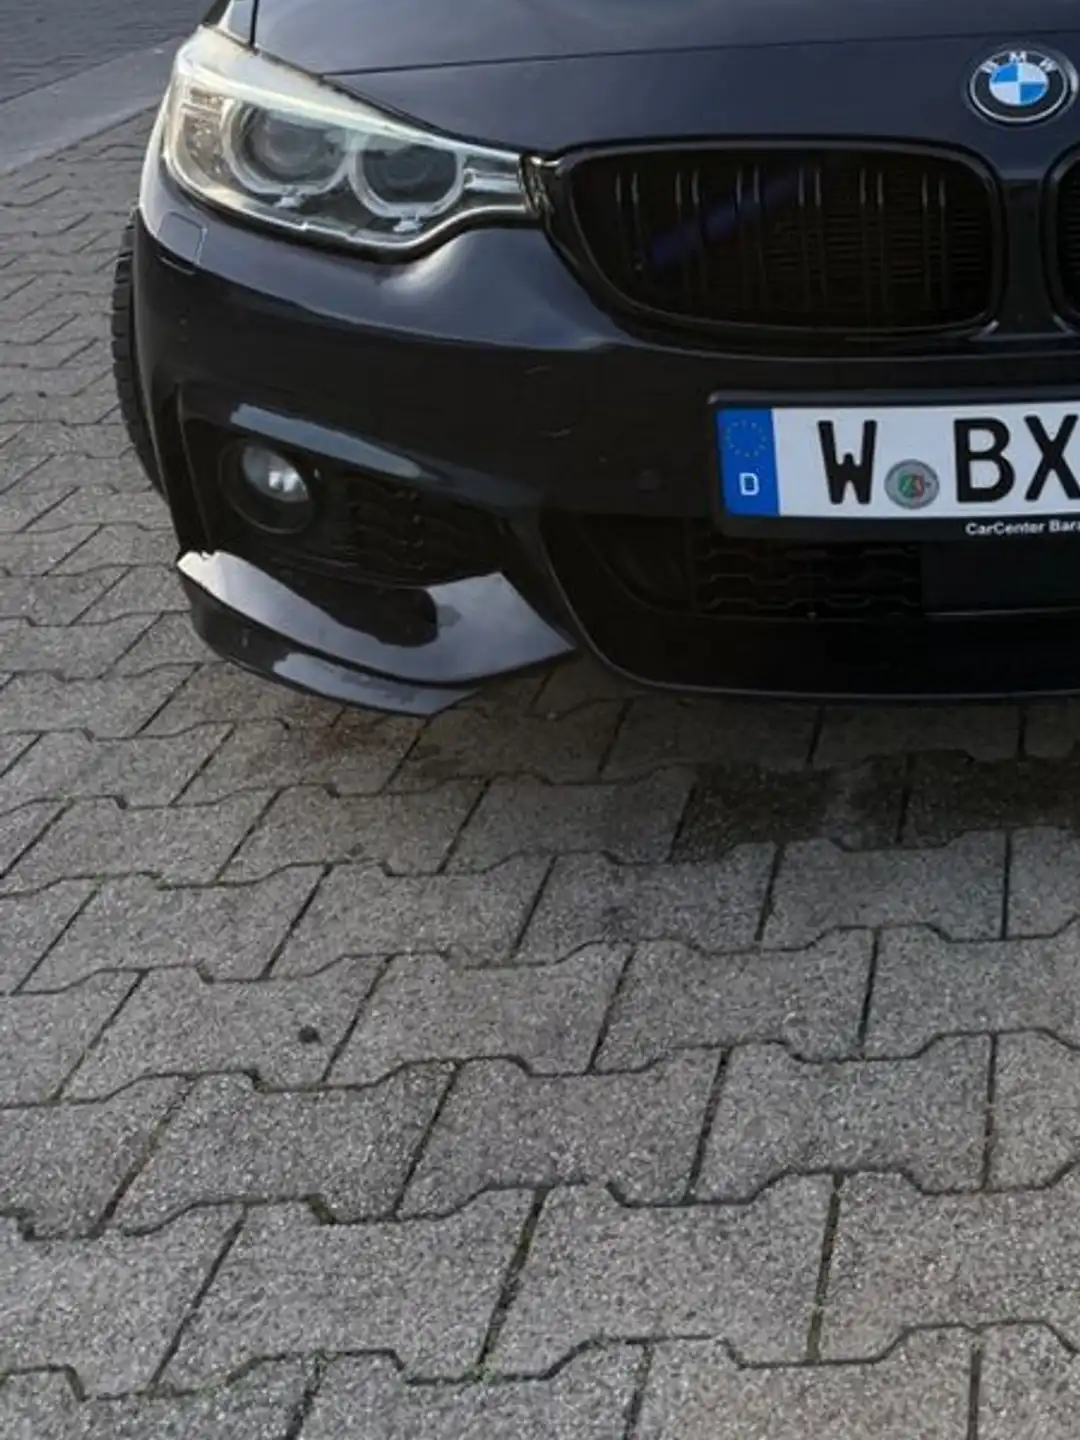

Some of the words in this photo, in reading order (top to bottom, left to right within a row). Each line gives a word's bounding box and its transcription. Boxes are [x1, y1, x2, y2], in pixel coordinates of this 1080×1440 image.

[817, 420, 878, 505] W
[740, 473, 760, 496] D
[965, 521, 1045, 536] CarCenter
